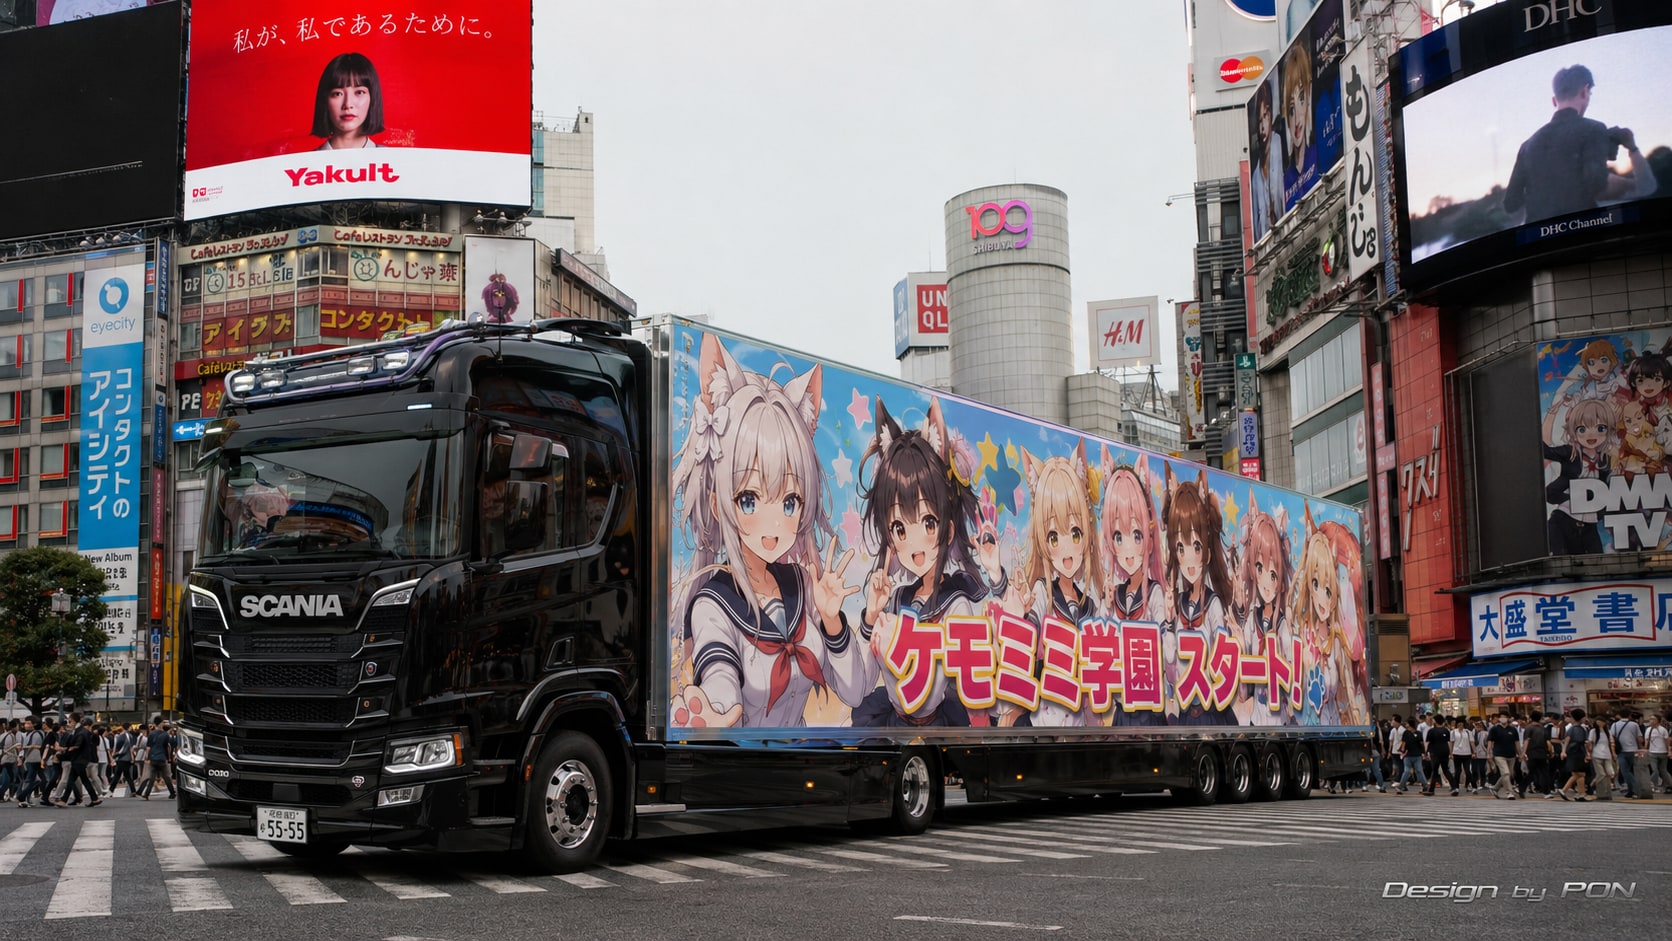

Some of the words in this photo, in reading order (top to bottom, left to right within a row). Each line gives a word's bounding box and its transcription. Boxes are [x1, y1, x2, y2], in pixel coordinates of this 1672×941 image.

[233, 12, 492, 54] 私が、私であるために。
[284, 163, 400, 187] Yakult
[965, 200, 1033, 249] 109
[1540, 222, 1567, 237] DHC
[1569, 212, 1613, 231] Channel
[973, 240, 1013, 256] SHIBUYA
[91, 317, 136, 334] eyecity
[1104, 319, 1144, 347] H&M
[88, 370, 112, 520] アイシティ
[112, 367, 133, 519] コンタクトの
[1604, 511, 1667, 550] TV
[105, 552, 132, 562] Album
[240, 594, 344, 618] SCANIA
[886, 608, 1164, 713] ケモミミ学園
[267, 820, 304, 840] 55-55
